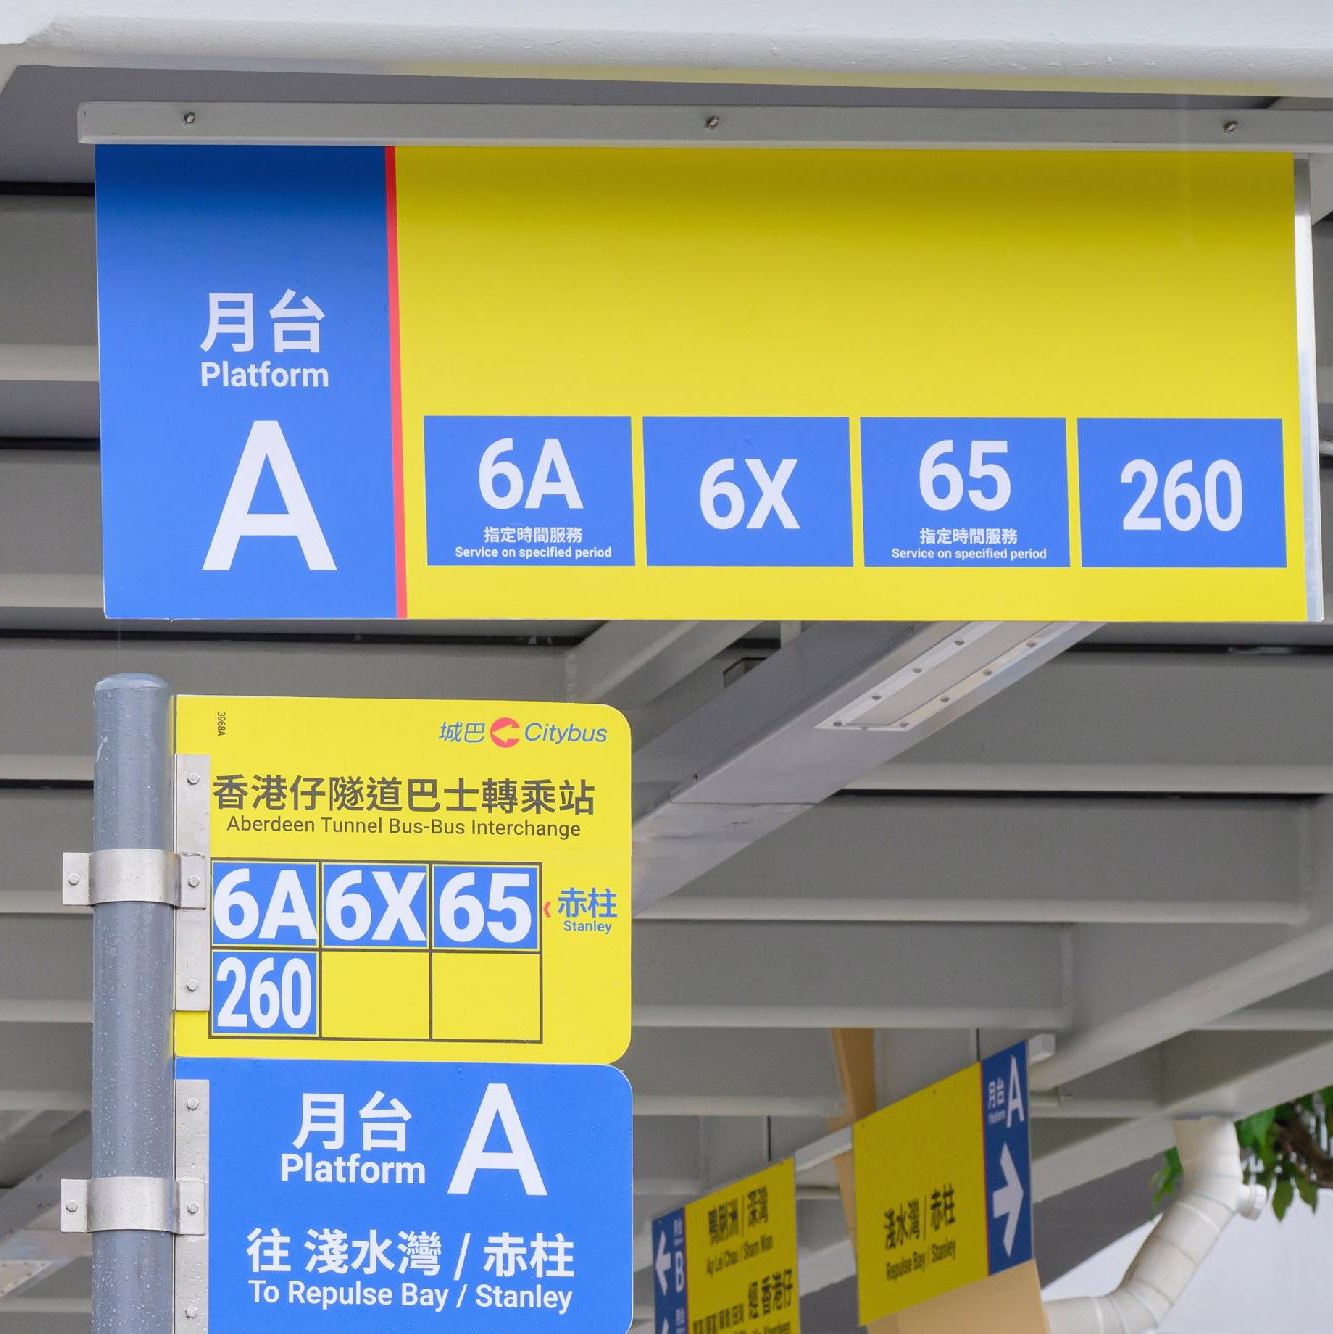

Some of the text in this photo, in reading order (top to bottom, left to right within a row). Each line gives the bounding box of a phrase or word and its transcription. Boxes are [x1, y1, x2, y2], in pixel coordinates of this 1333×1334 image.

[199, 288, 326, 353] 月台
[200, 361, 329, 387] Platform
[478, 437, 584, 510] 6A
[699, 457, 801, 530] 6X
[919, 439, 1012, 512] 65
[202, 420, 338, 570] A
[1120, 458, 1243, 532] 260
[455, 546, 612, 560] Service on specified period
[483, 526, 583, 544] 指定時間服務
[891, 547, 1047, 560] Service on specified period
[919, 527, 1019, 545] 指定時間服務
[216, 711, 226, 737] 3968A
[438, 721, 607, 745] 城巴 Citybus
[212, 774, 596, 815] 香港仔隧道巴士轉乘站
[226, 815, 581, 839] Aberdeen Tunnel Bus-Bus Interchange
[213, 868, 532, 943] 6A 6X 65
[557, 888, 618, 919] 赤柱
[562, 919, 612, 934] Stanley
[216, 956, 312, 1029] 260
[1006, 1054, 1025, 1129] A
[292, 1090, 412, 1152] 月台
[447, 1082, 548, 1196] A
[280, 1153, 426, 1184] Platform
[246, 1227, 575, 1281] 往 淺水灣 / 赤柱
[248, 1280, 573, 1315] To Repulse Bay / Stanley
